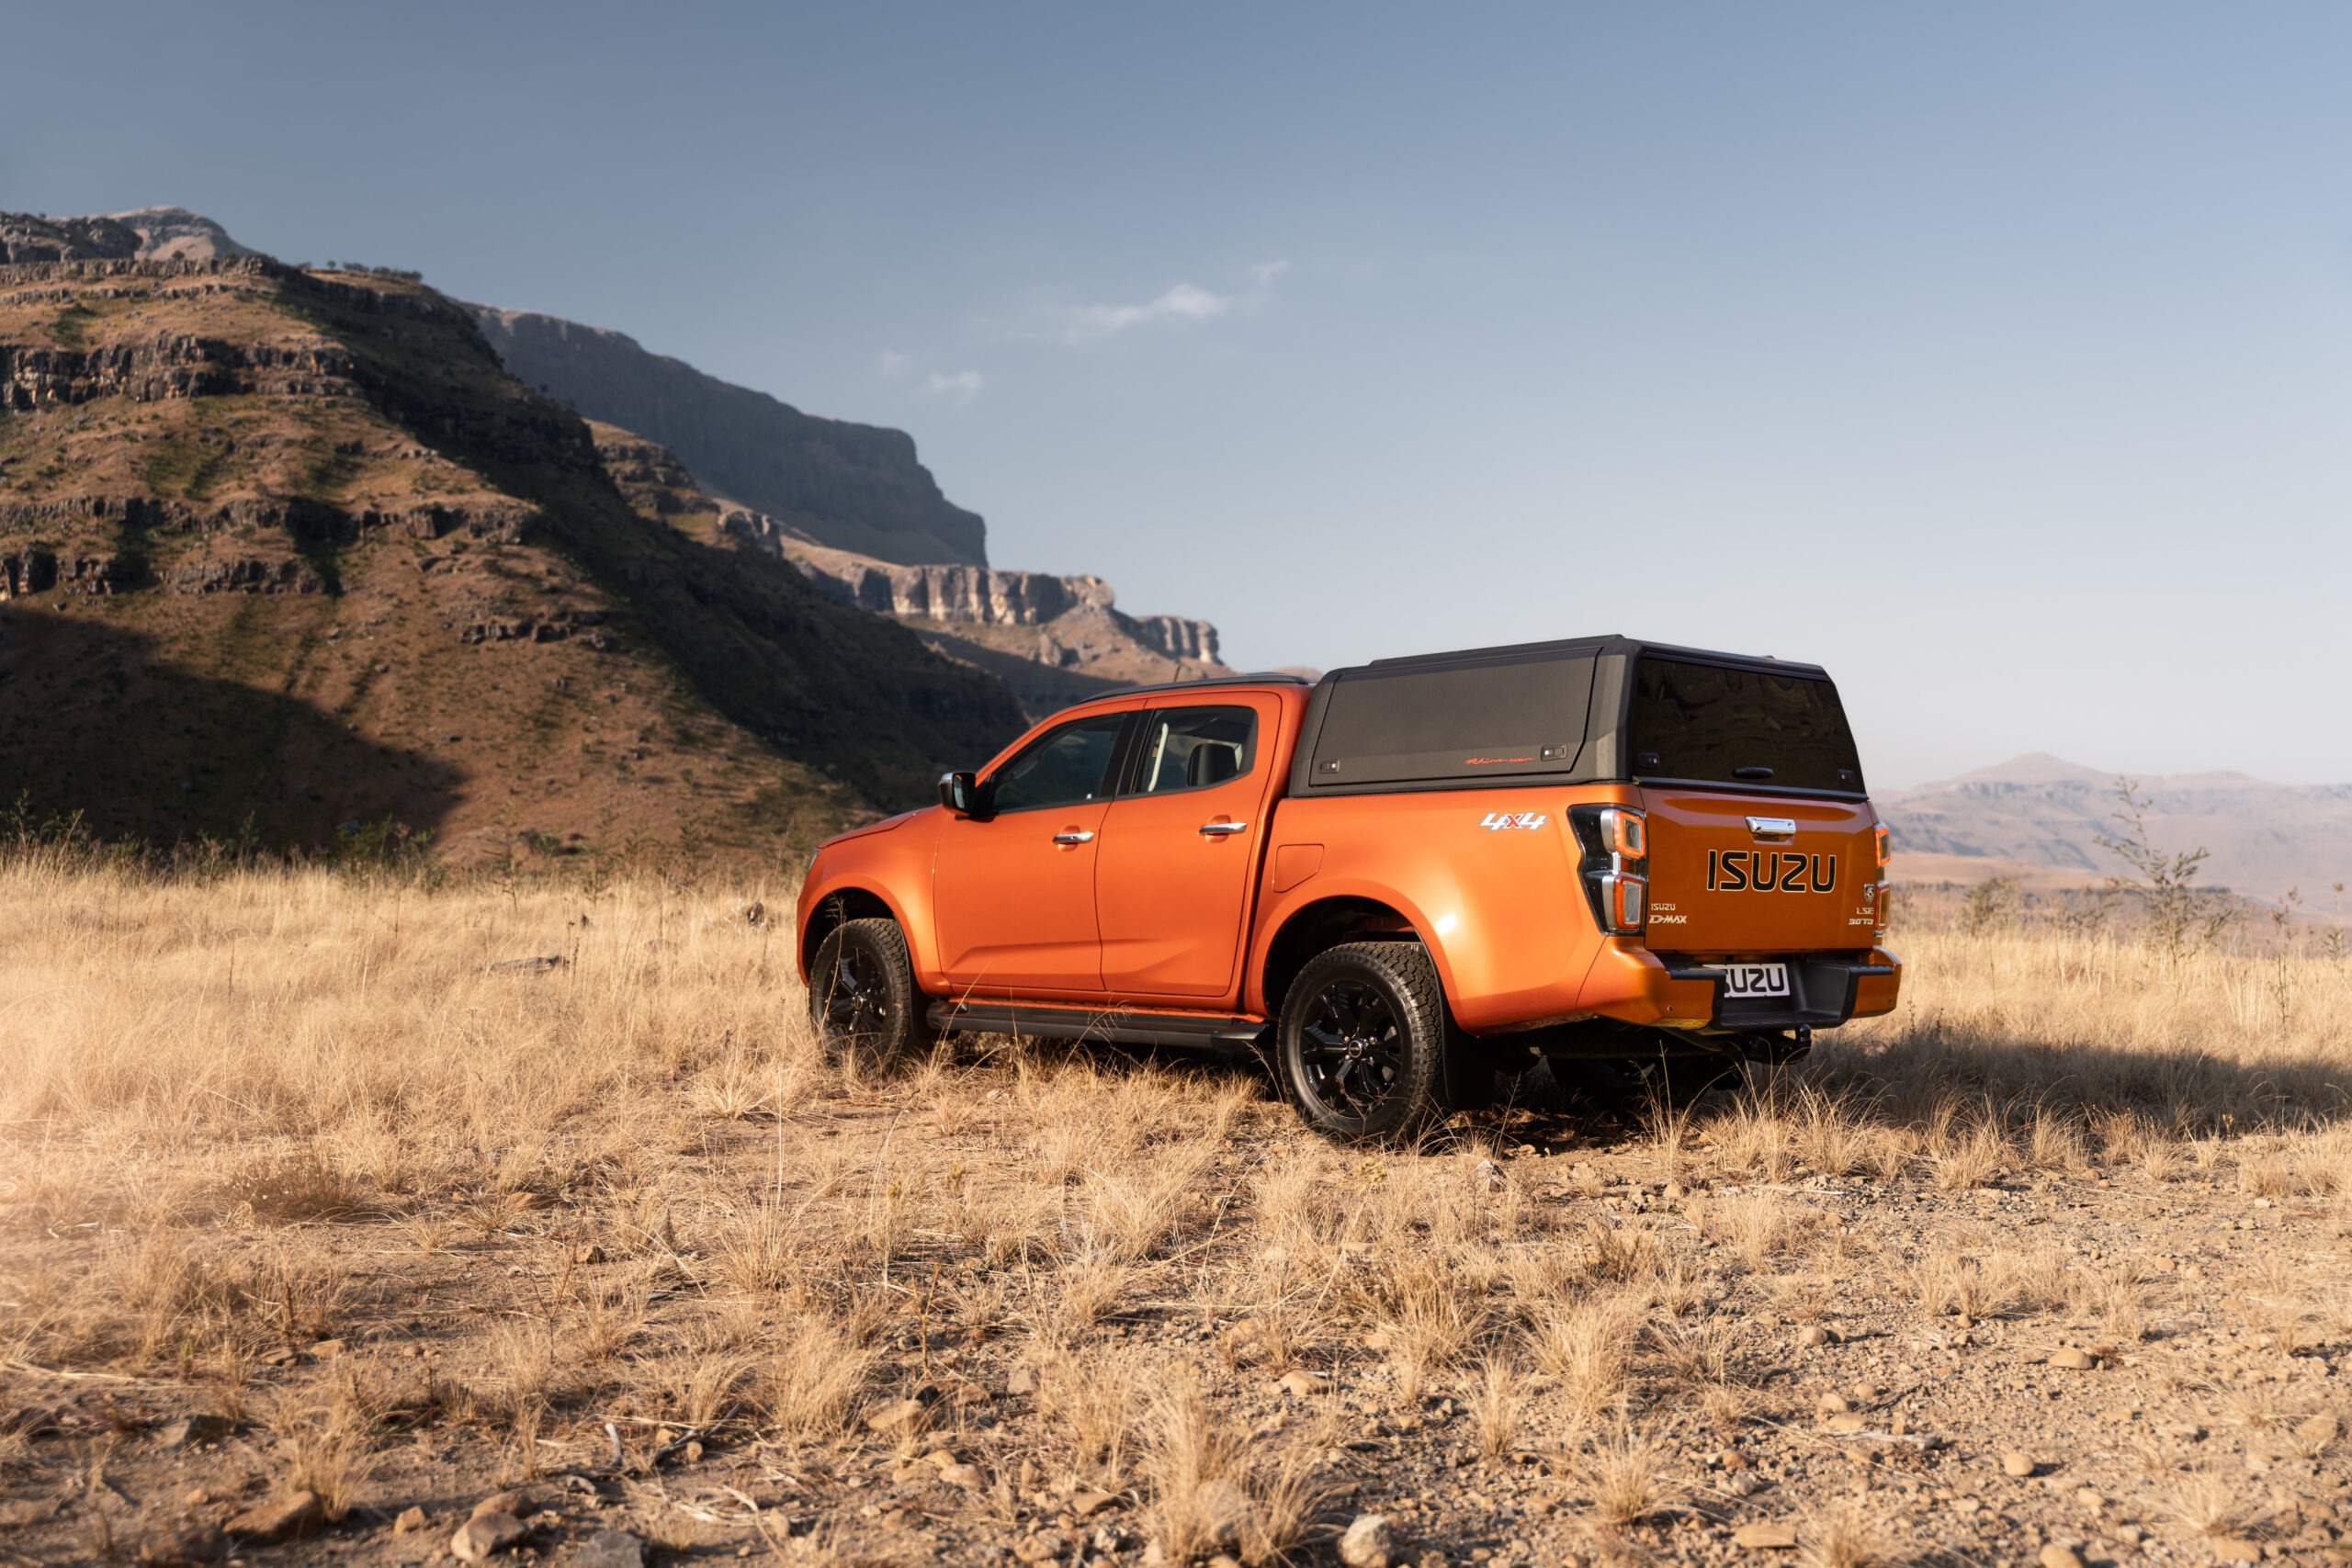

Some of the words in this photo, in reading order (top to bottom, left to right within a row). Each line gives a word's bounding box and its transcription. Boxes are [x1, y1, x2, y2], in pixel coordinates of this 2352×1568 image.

[1707, 850, 1836, 893] ISUZU
[1856, 907, 1874, 915] LSE
[1648, 914, 1688, 924] D-MAX
